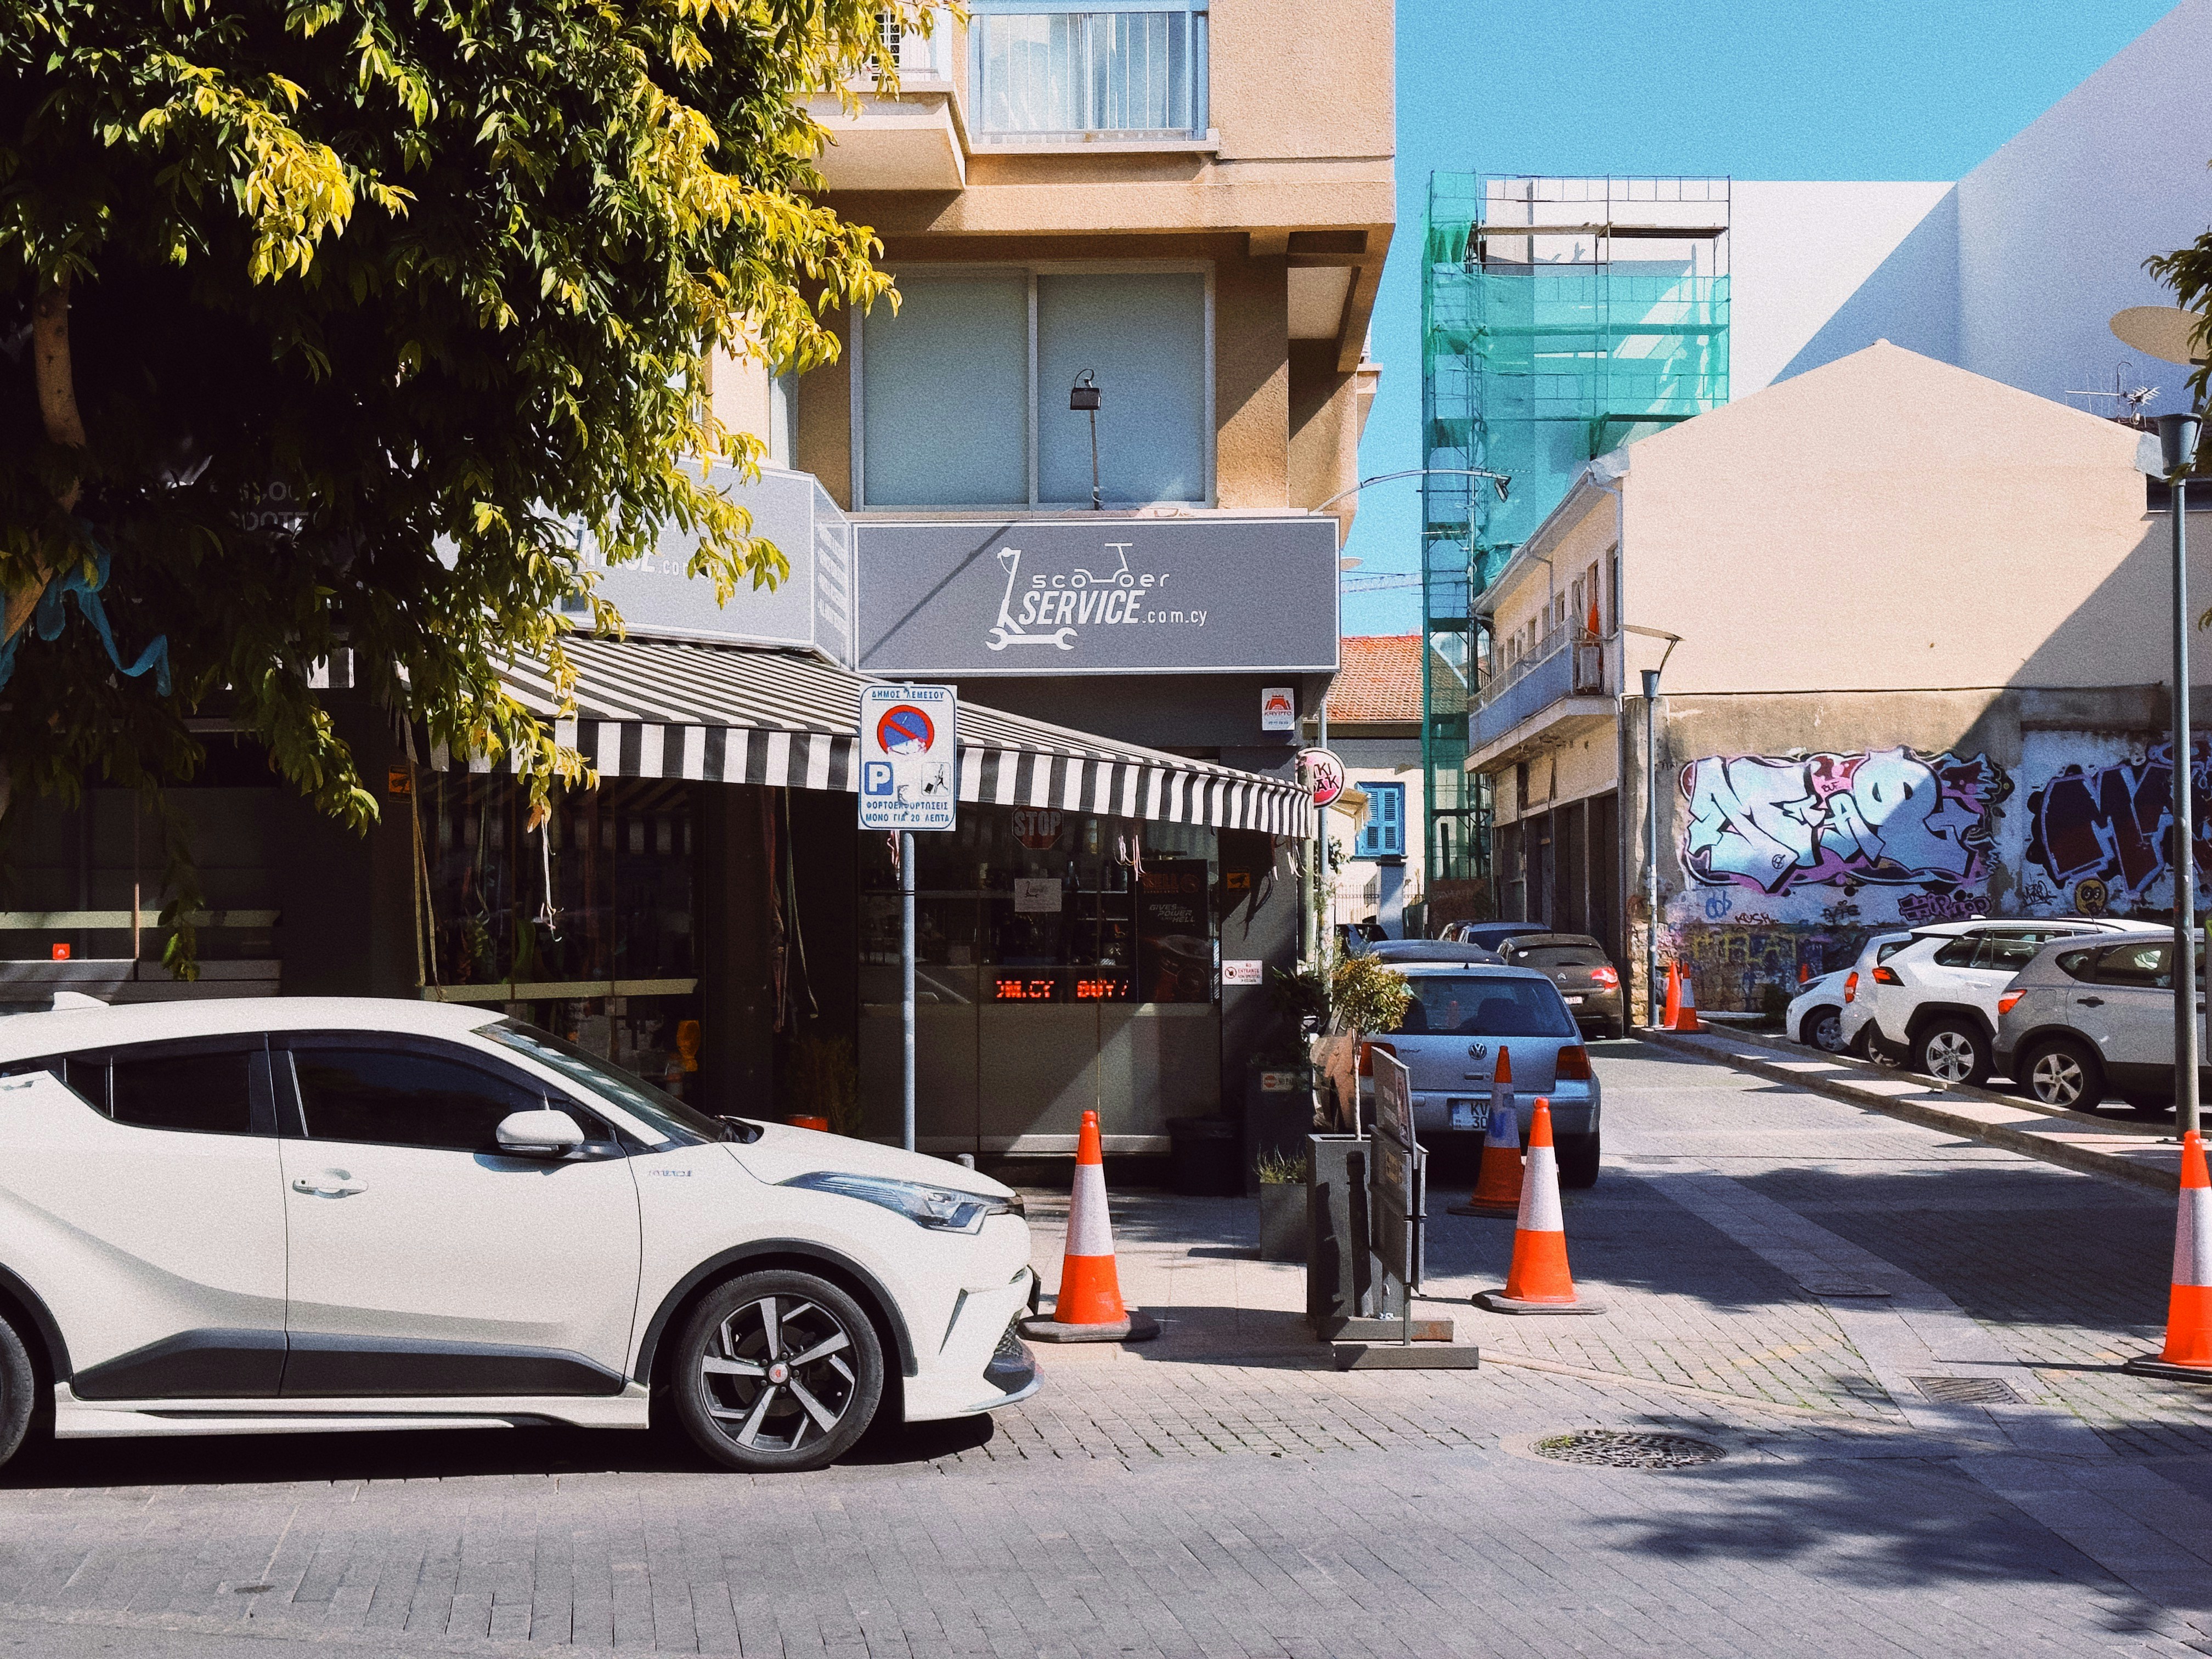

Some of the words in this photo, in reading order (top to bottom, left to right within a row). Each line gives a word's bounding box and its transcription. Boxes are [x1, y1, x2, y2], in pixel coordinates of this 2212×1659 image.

[1014, 810, 1062, 837] STOP
[1470, 1103, 1491, 1116] KV
[1472, 1116, 1488, 1129] 30
